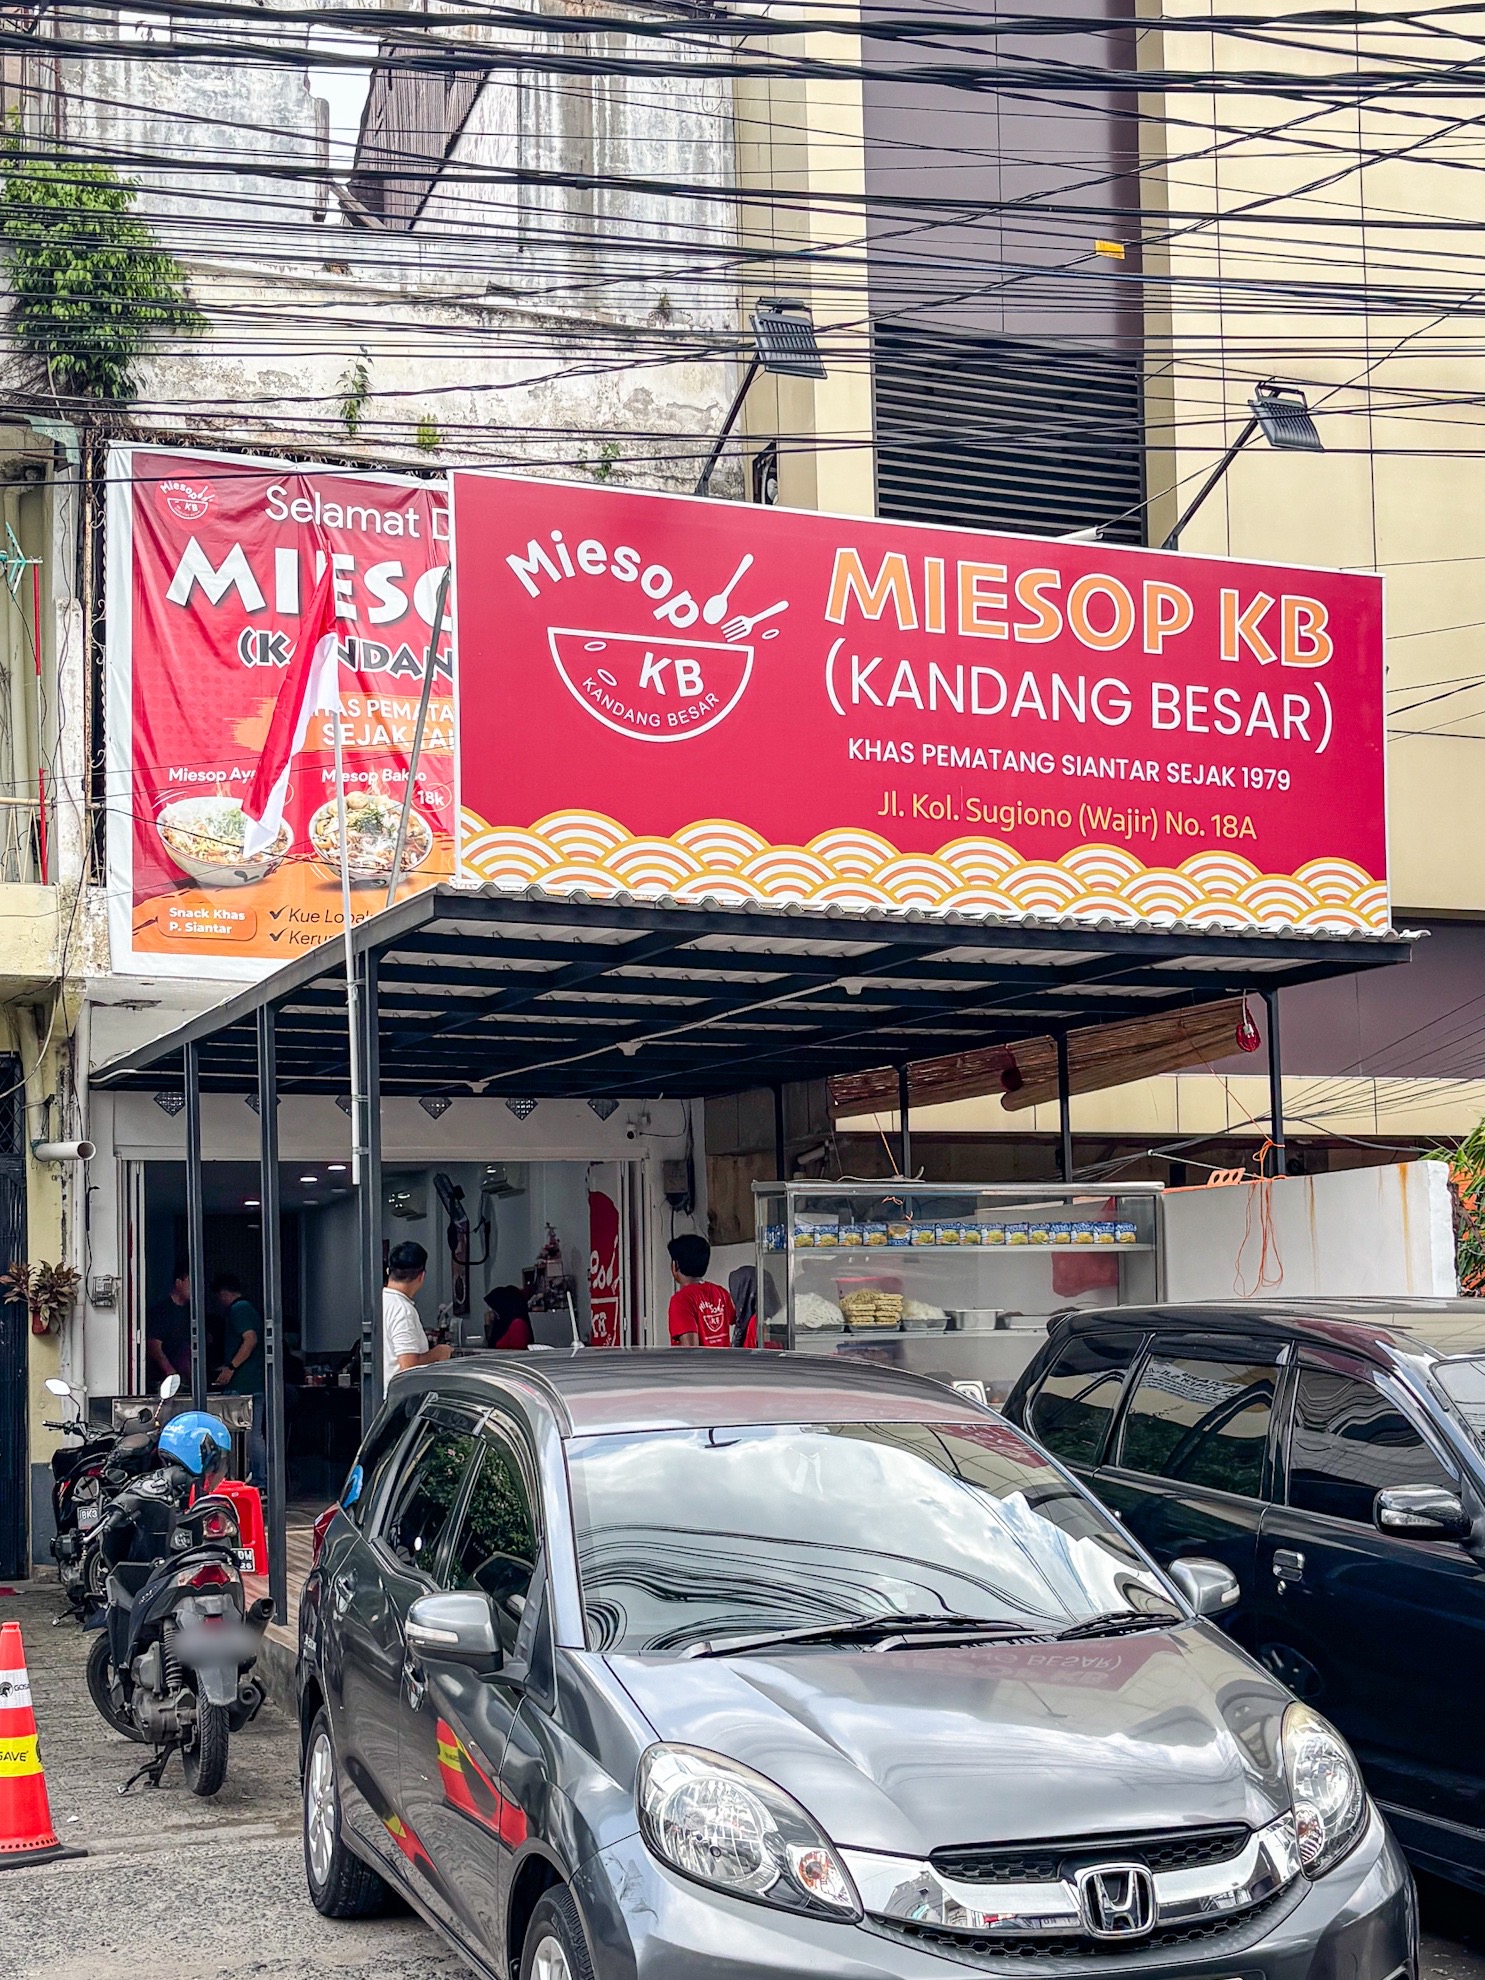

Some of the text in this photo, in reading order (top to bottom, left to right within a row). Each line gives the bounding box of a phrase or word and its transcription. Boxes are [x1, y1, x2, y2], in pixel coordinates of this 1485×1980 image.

[264, 485, 420, 538] Selamat
[505, 529, 700, 629] Miesop
[824, 547, 1334, 669] MIESOP KB
[237, 626, 453, 682] (KNDAN
[638, 652, 705, 697] KB
[582, 677, 720, 727] KANDANG BESAR
[825, 637, 1333, 754] (KANDANG BESAR)
[322, 724, 410, 747] SEJAK
[168, 768, 227, 786] Miesop
[321, 769, 379, 784] Mesop
[848, 737, 1291, 791] KHAS PEMATANG SIANTAR SEJAK 1979
[417, 789, 446, 806] 18k
[877, 791, 1257, 841] Jl. Kol. Sugiono (Wajir) No. 18A
[169, 906, 246, 921] Snack Khas
[169, 921, 232, 935] P. Siantar
[289, 908, 320, 923] Kue
